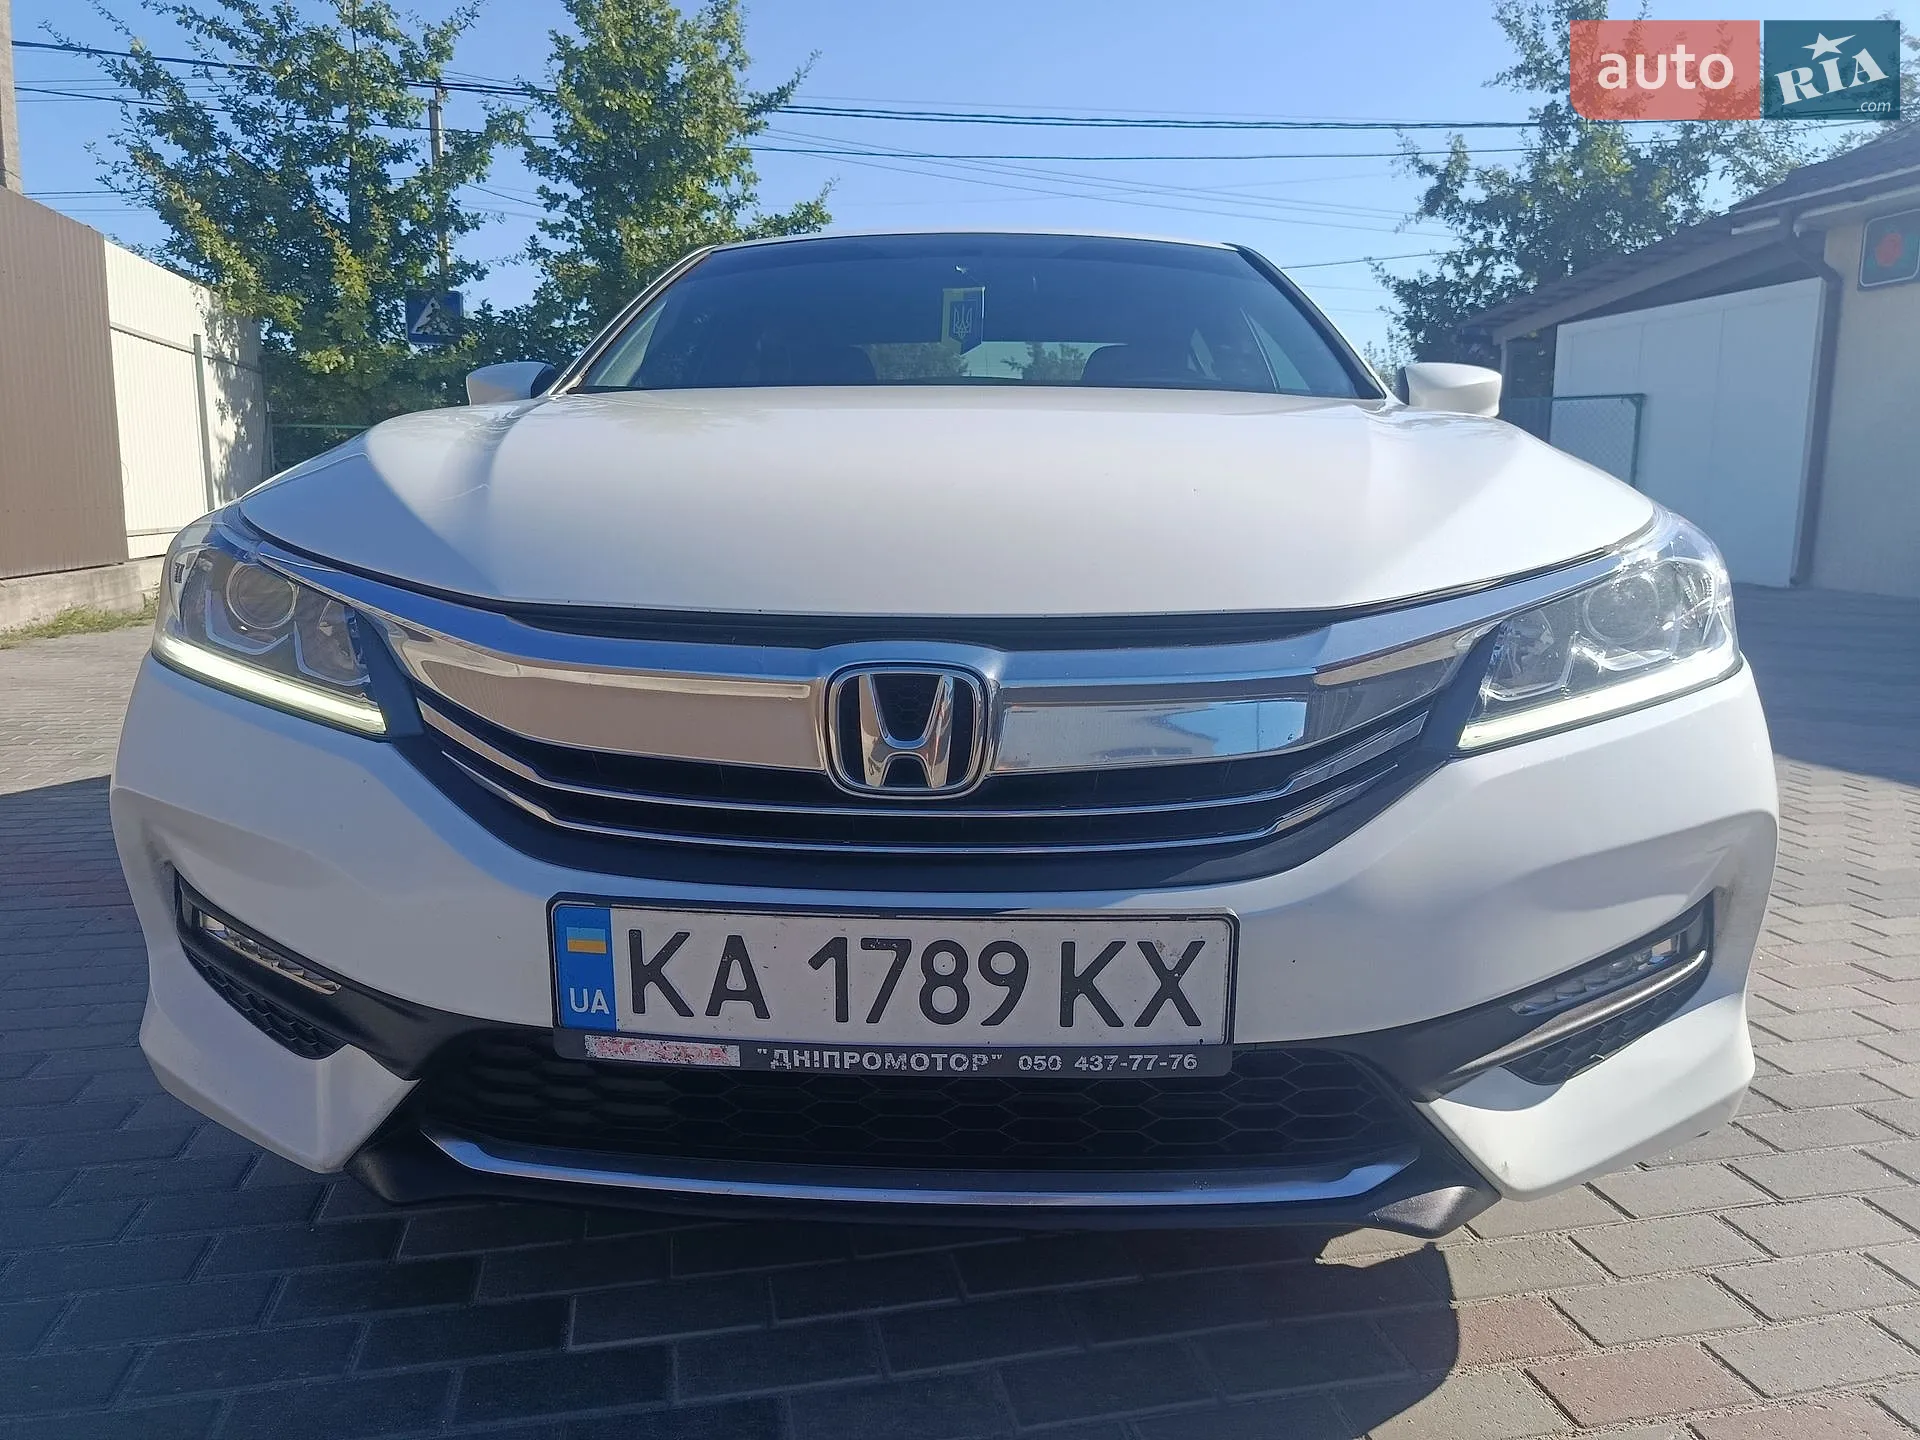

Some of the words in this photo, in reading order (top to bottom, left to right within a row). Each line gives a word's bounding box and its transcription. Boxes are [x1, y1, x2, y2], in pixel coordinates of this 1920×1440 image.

[628, 929, 771, 1020] KA
[807, 936, 1029, 1026] 1789
[1060, 940, 1206, 1028] KX
[569, 987, 610, 1014] UA
[757, 1048, 1004, 1072] "ДНІПРОМОТОР"
[1018, 1054, 1062, 1071] 050
[1074, 1053, 1198, 1071] 437-77-76
